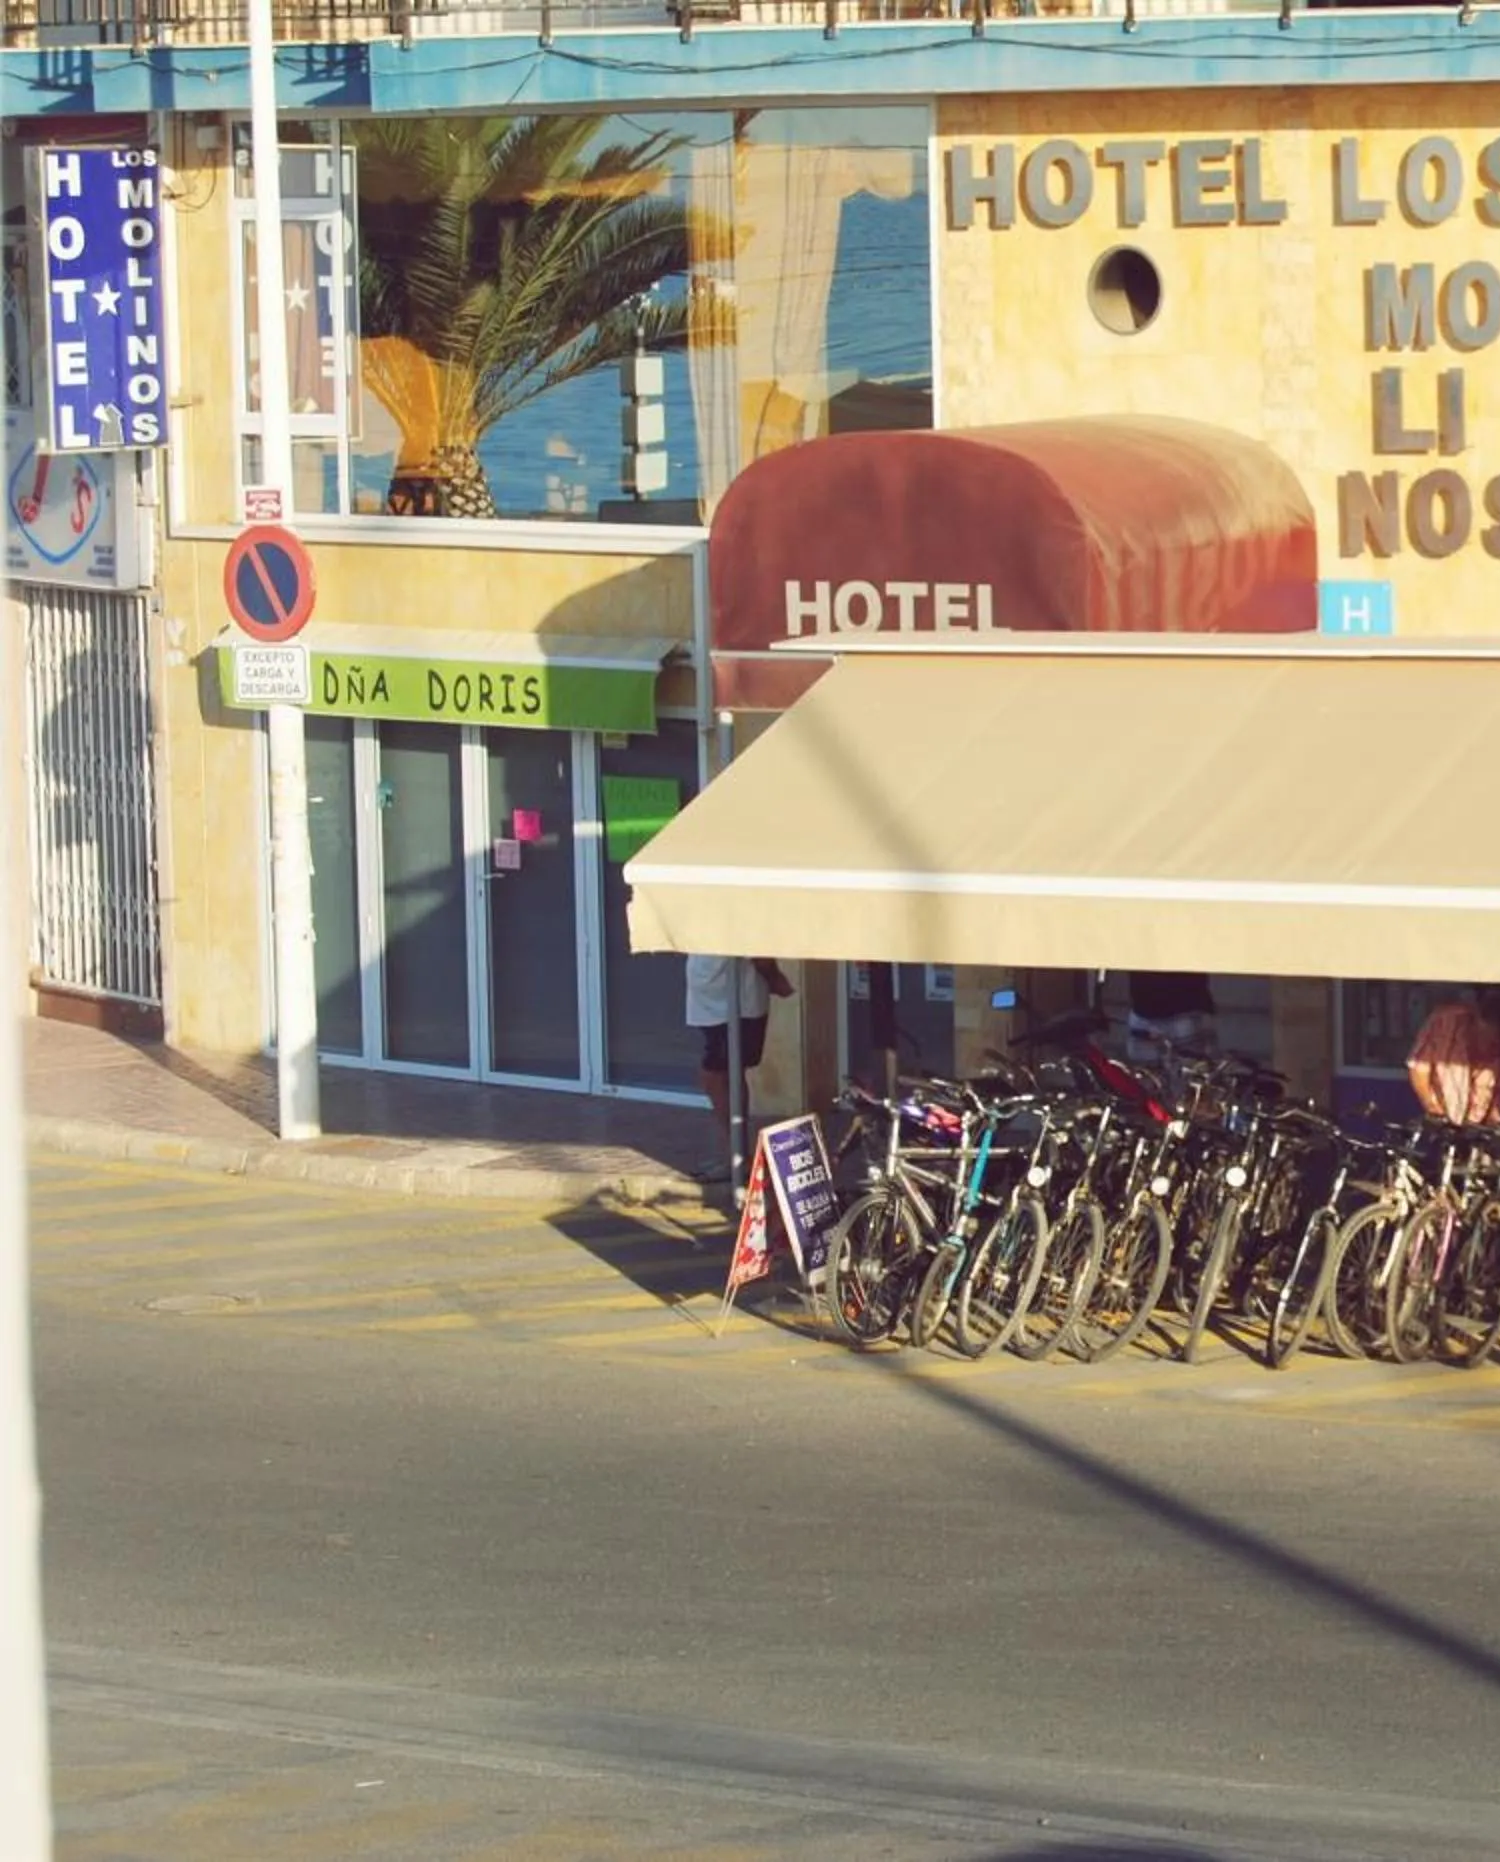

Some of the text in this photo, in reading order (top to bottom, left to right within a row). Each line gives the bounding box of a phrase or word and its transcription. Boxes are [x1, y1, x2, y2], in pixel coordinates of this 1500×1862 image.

[111, 150, 157, 168] LOS
[945, 137, 1287, 231] HOTEL
[46, 153, 90, 447] HOTEL
[117, 178, 160, 443] MOLINOS
[1371, 367, 1465, 455] LI
[785, 580, 1012, 635] HOTEL
[1342, 595, 1370, 632] H
[243, 651, 295, 662] EXCEPTO
[245, 667, 295, 678] CARGA Y
[240, 683, 301, 695] DESCARGA
[322, 661, 541, 715] DÑA DORIS
